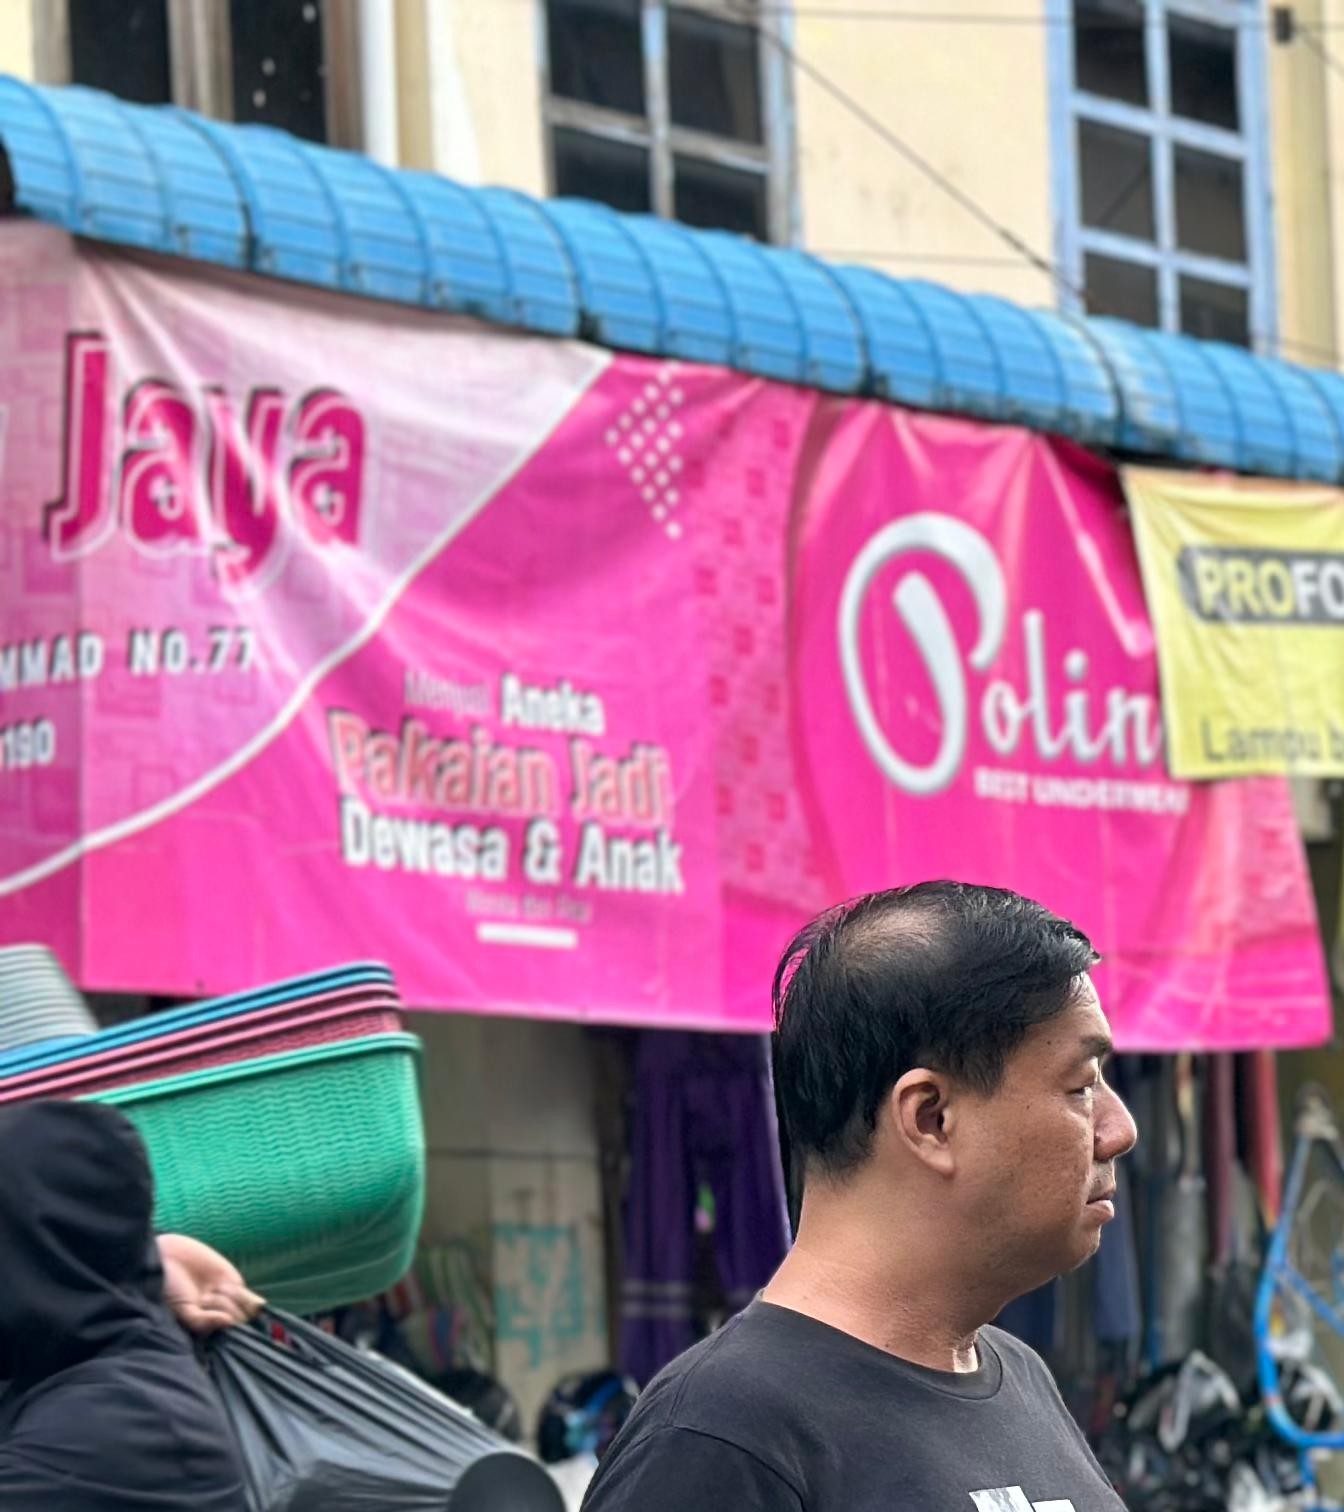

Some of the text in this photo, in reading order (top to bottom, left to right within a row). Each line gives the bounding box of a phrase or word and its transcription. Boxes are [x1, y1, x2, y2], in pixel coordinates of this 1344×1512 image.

[42, 332, 371, 602] Jaya
[127, 622, 254, 677] NO.77
[500, 672, 606, 736] Aneka
[328, 706, 674, 828] Pakaian Jadi
[340, 793, 685, 895] Dewasa & Anak
